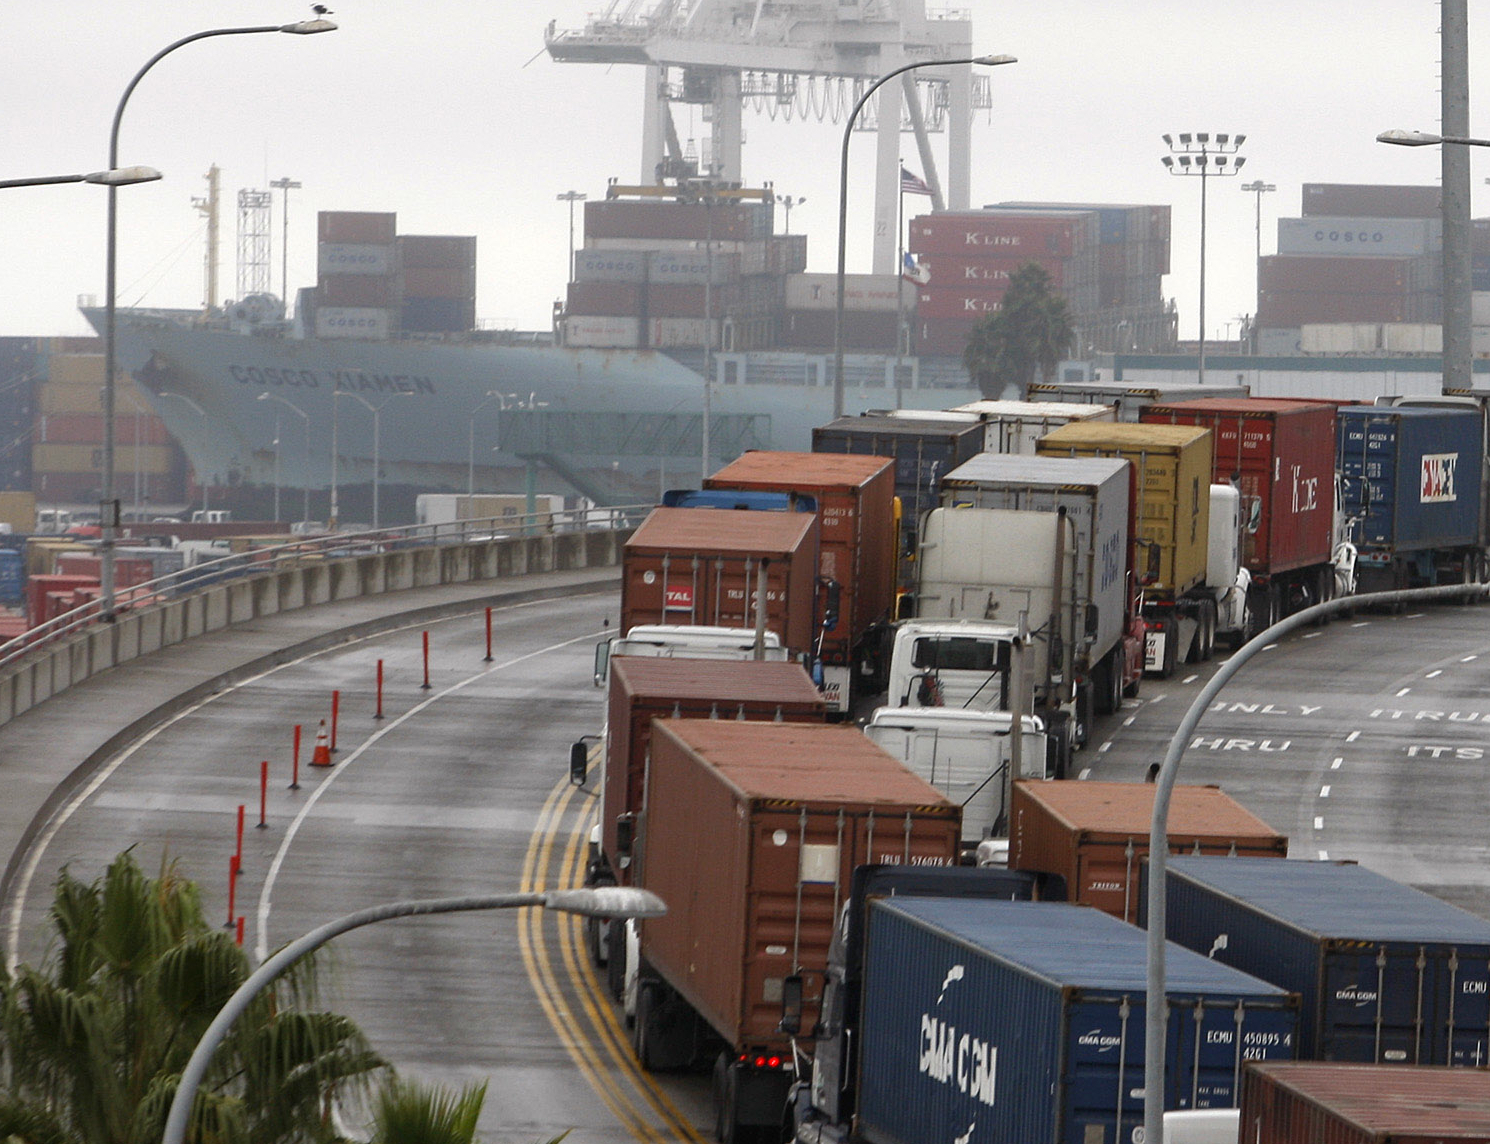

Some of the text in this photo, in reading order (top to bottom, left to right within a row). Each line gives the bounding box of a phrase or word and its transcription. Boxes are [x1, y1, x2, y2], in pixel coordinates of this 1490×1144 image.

[876, 221, 887, 236] 22
[984, 236, 1021, 246] LINE
[1314, 230, 1384, 243] COSCO
[328, 253, 377, 264] COSCO
[586, 261, 636, 270] COSCO
[983, 271, 1010, 279] LIN
[328, 318, 376, 328] COSCO
[228, 364, 437, 395] COSCO XIAMEN
[666, 591, 692, 601] TAL
[1190, 737, 1292, 752] HRU
[1407, 745, 1485, 760] ITS
[880, 854, 900, 866] TRLU
[1463, 981, 1487, 993] ECMU
[1336, 991, 1377, 1001] CMA CGM
[1078, 1036, 1121, 1046] CMA CGM
[1207, 1030, 1292, 1047] ECMU 450895 4
[919, 1013, 998, 1107] CMA CGM
[1243, 1048, 1267, 1060] 42G1
